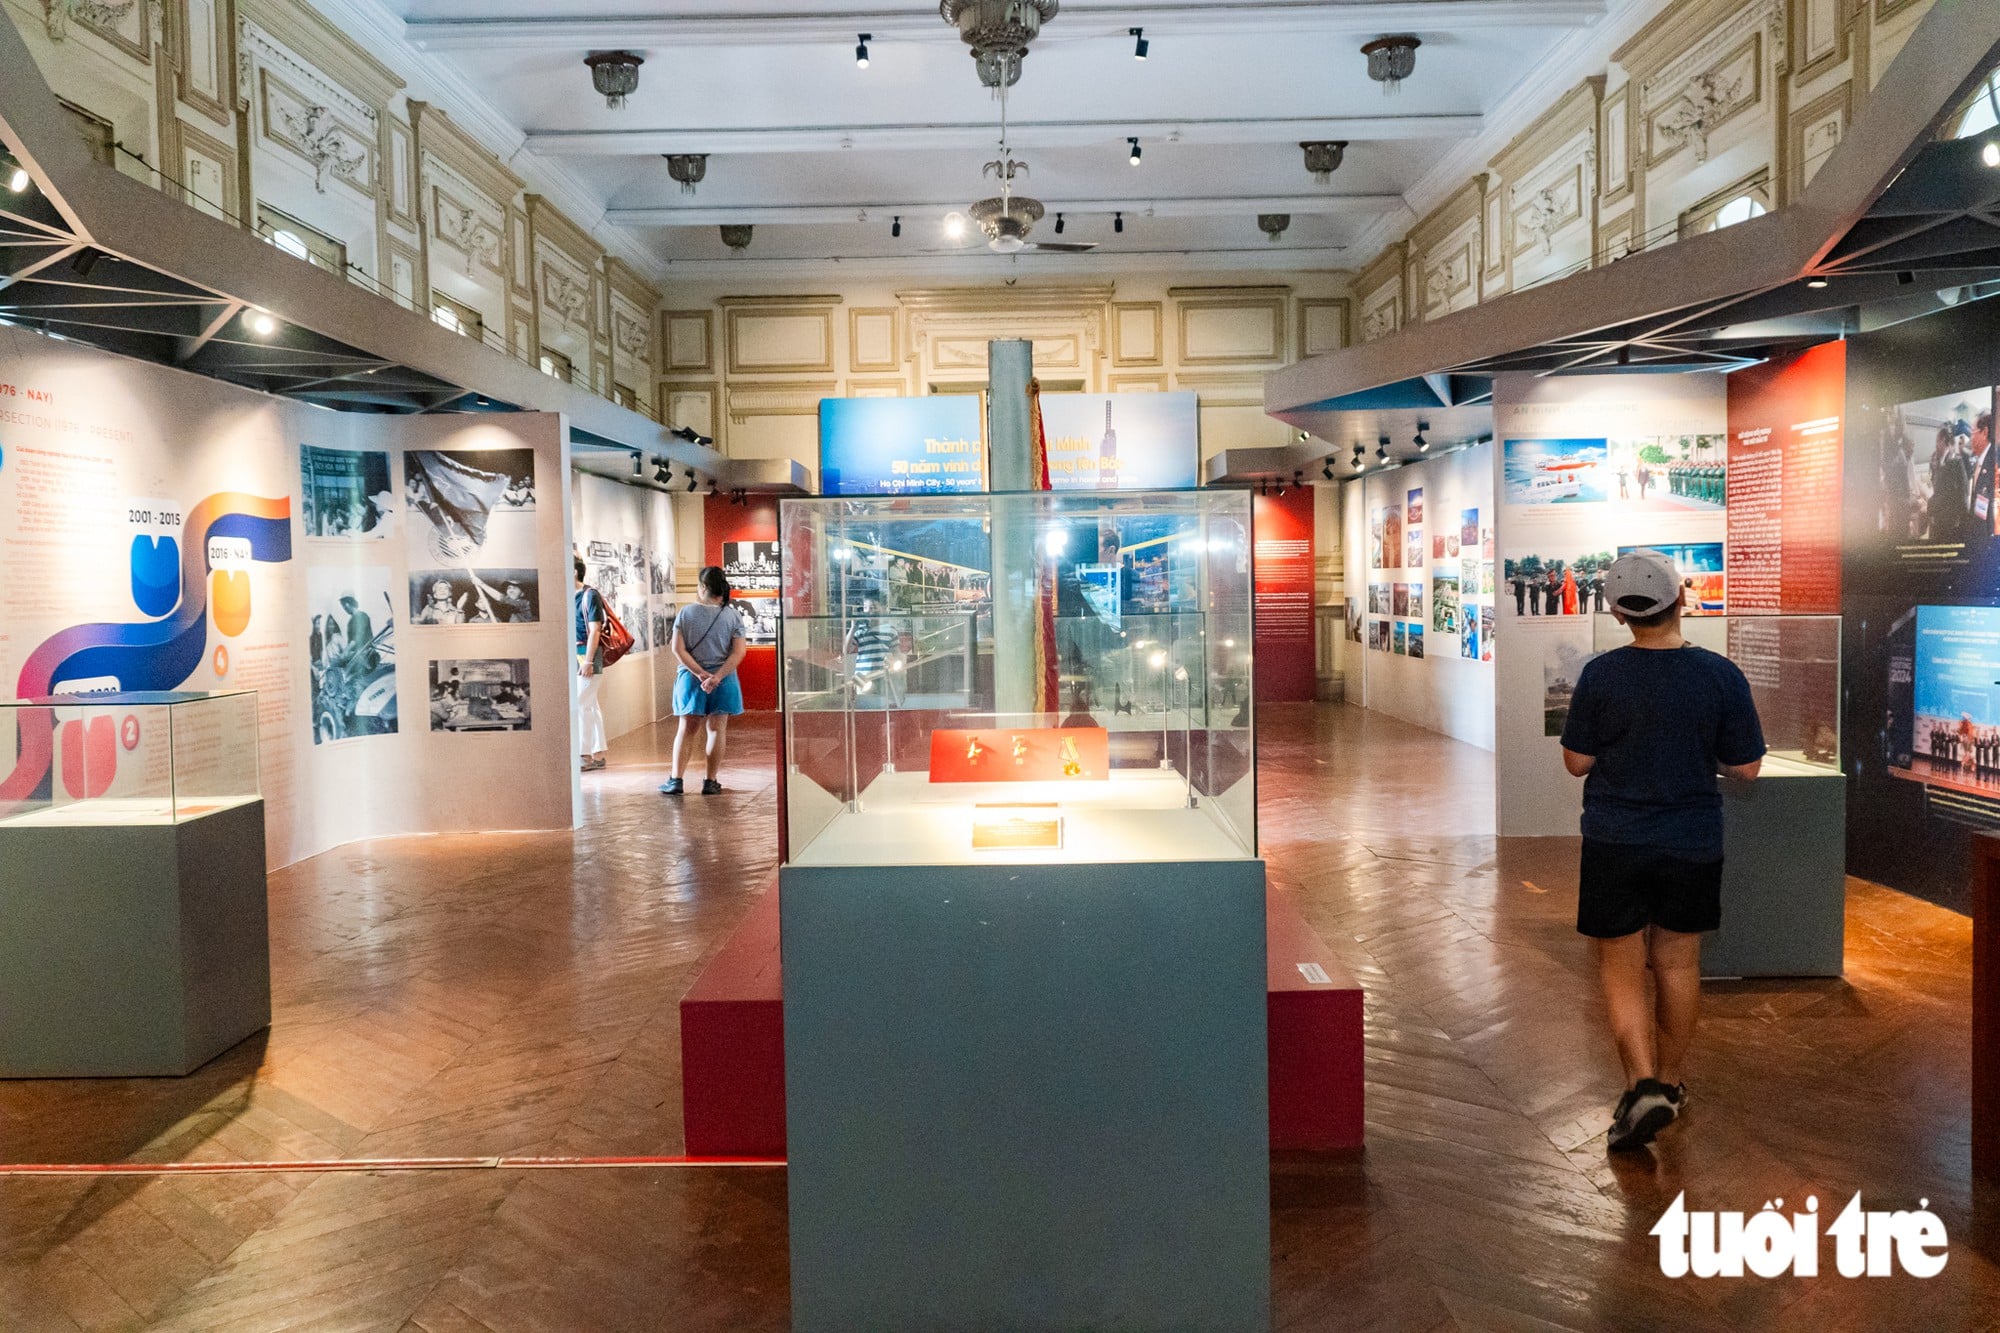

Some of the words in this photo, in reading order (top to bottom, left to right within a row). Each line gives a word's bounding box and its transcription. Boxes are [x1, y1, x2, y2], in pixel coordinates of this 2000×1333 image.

[26, 389, 53, 405] NAY)
[924, 437, 969, 454] Thành
[1056, 436, 1092, 451] Minh
[891, 460, 909, 474] 50
[910, 459, 940, 474] năm
[943, 460, 969, 472] vinh
[1049, 460, 1074, 474] ang
[880, 479, 891, 487] Ho
[892, 479, 906, 487] Chi
[907, 479, 925, 487] Minh
[926, 479, 941, 488] City
[128, 509, 152, 524] 2001
[159, 512, 180, 526] 2015
[210, 547, 228, 559] 2016
[125, 720, 135, 741] 2
